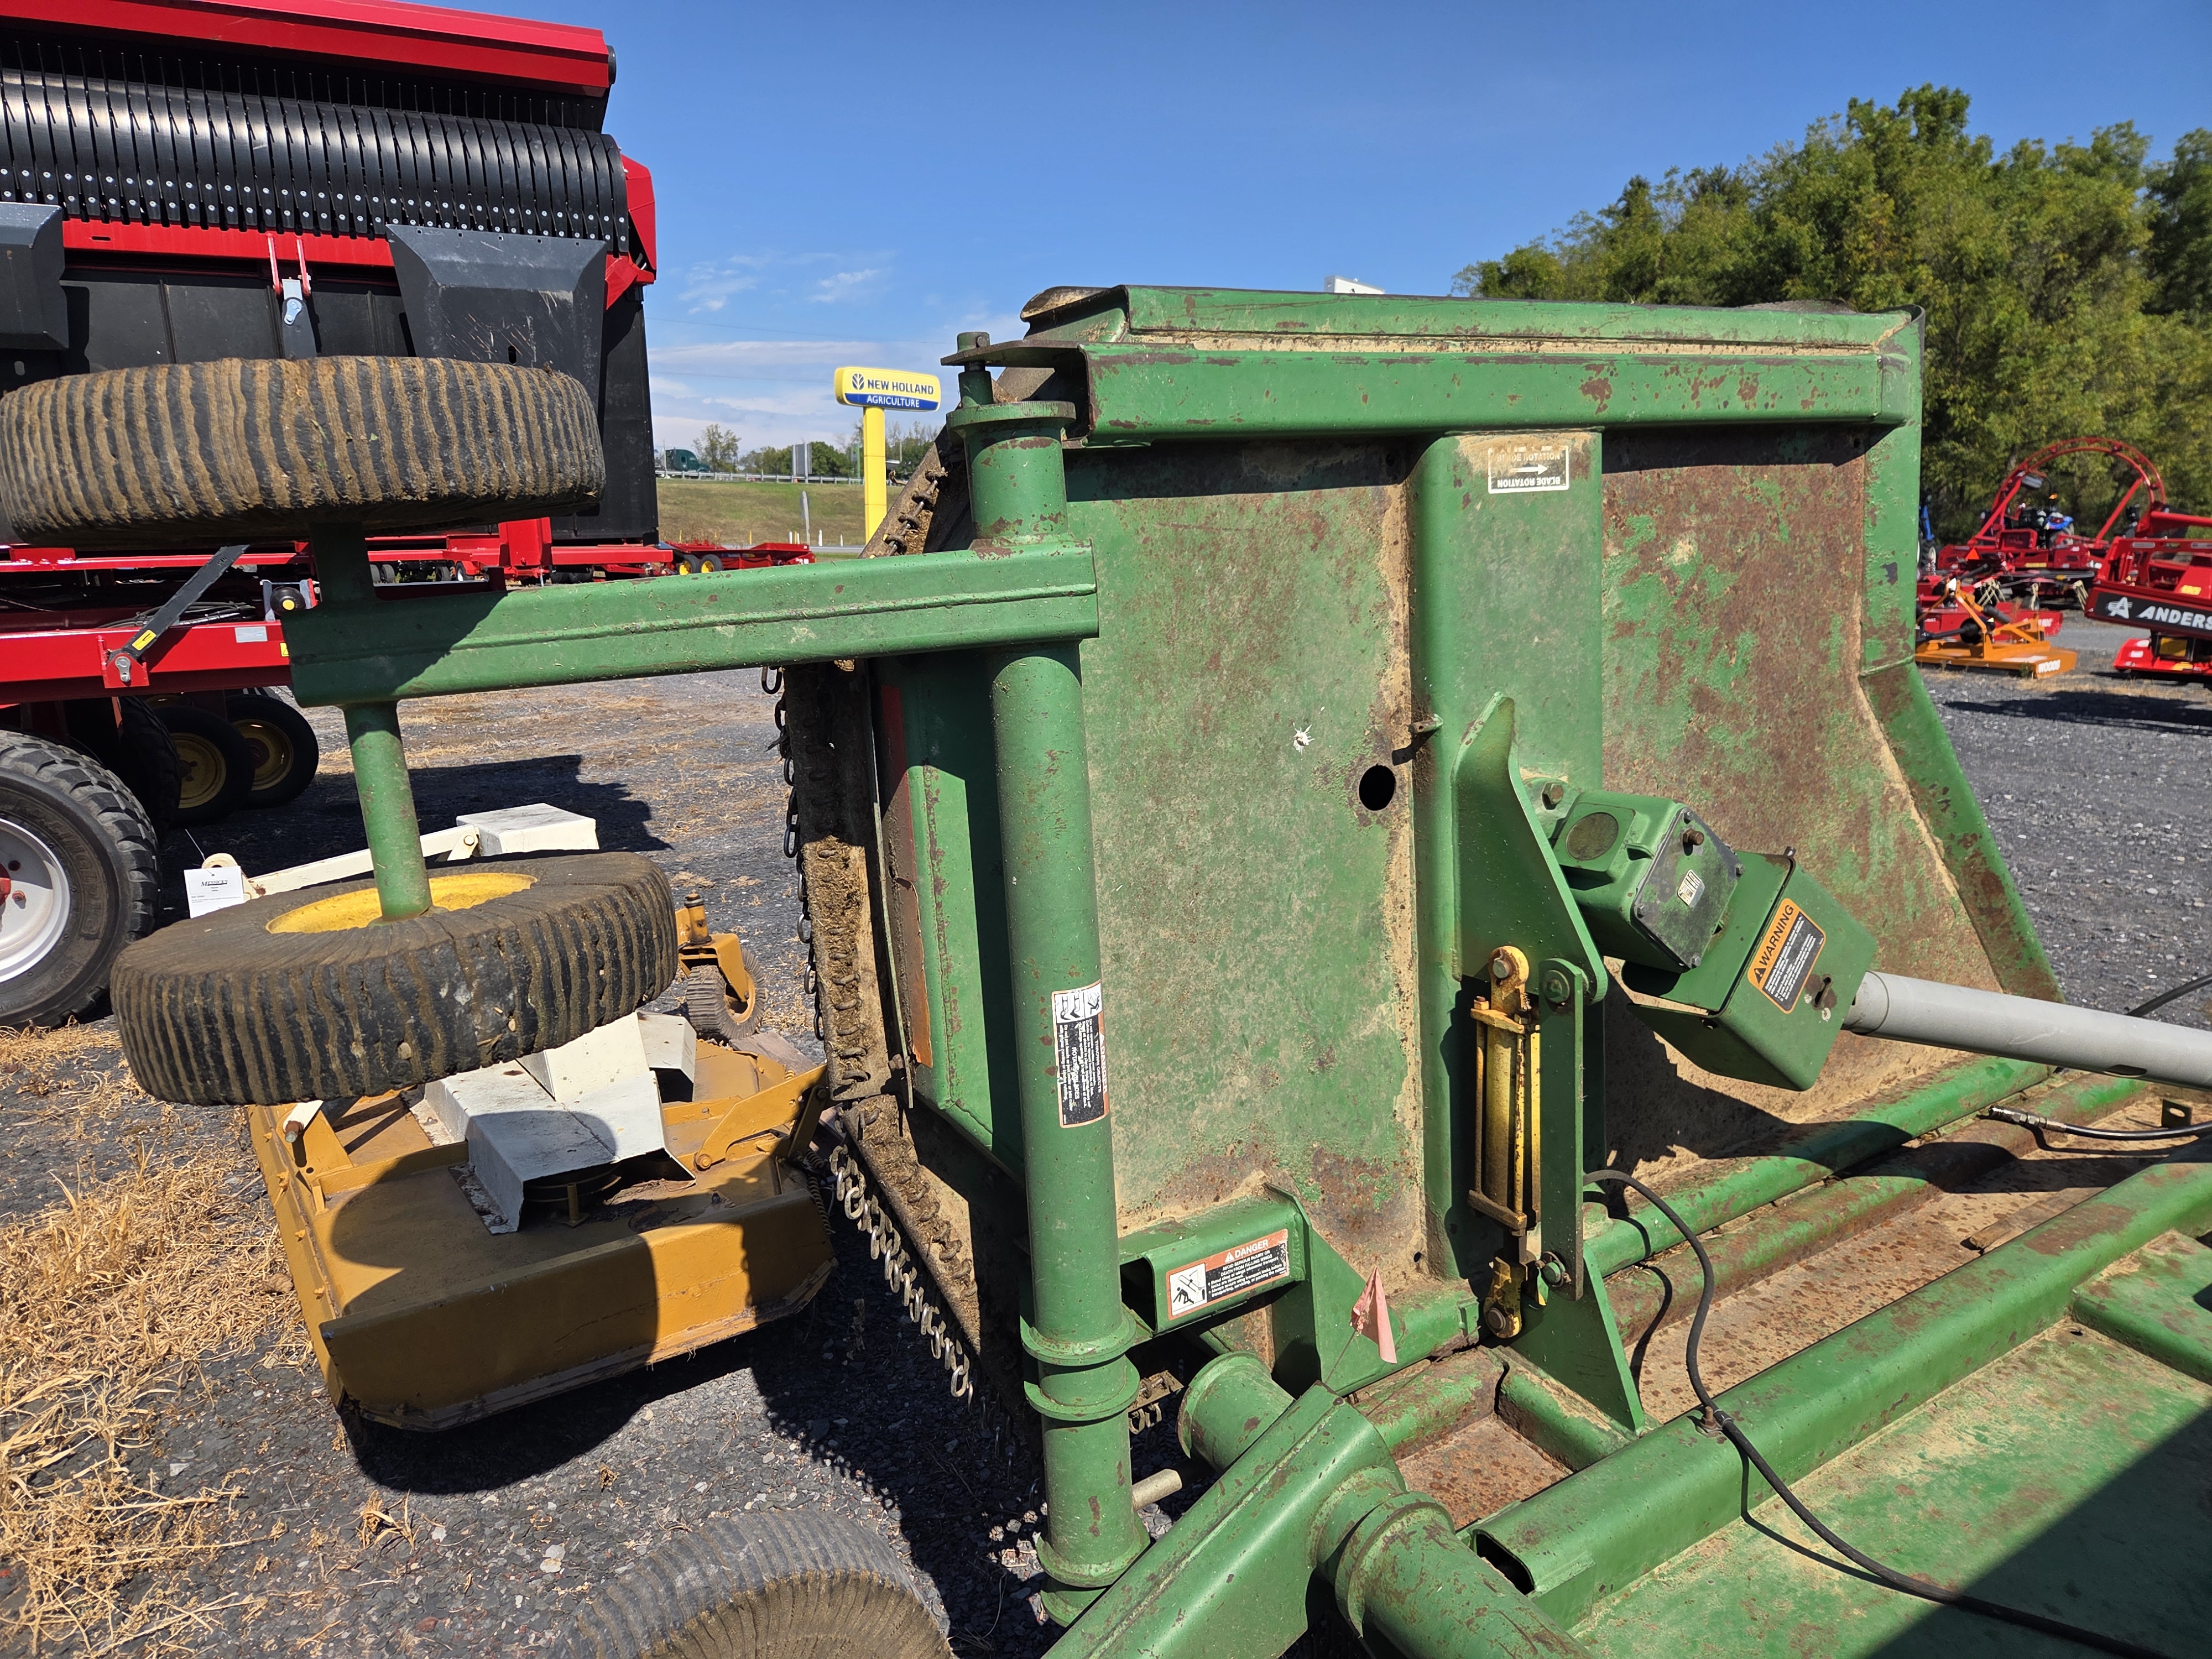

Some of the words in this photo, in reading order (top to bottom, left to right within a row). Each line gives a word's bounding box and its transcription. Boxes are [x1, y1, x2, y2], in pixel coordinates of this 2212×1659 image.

[867, 379, 889, 390] NEW
[892, 382, 933, 395] HOLLAND
[867, 395, 920, 408] AGRICULTURE
[1497, 478, 1535, 488] ROTATION
[1537, 476, 1561, 486] BLADE
[2038, 659, 2060, 674] WOODS
[1759, 904, 1794, 966] WARNING
[1234, 1239, 1268, 1256] DANGER
